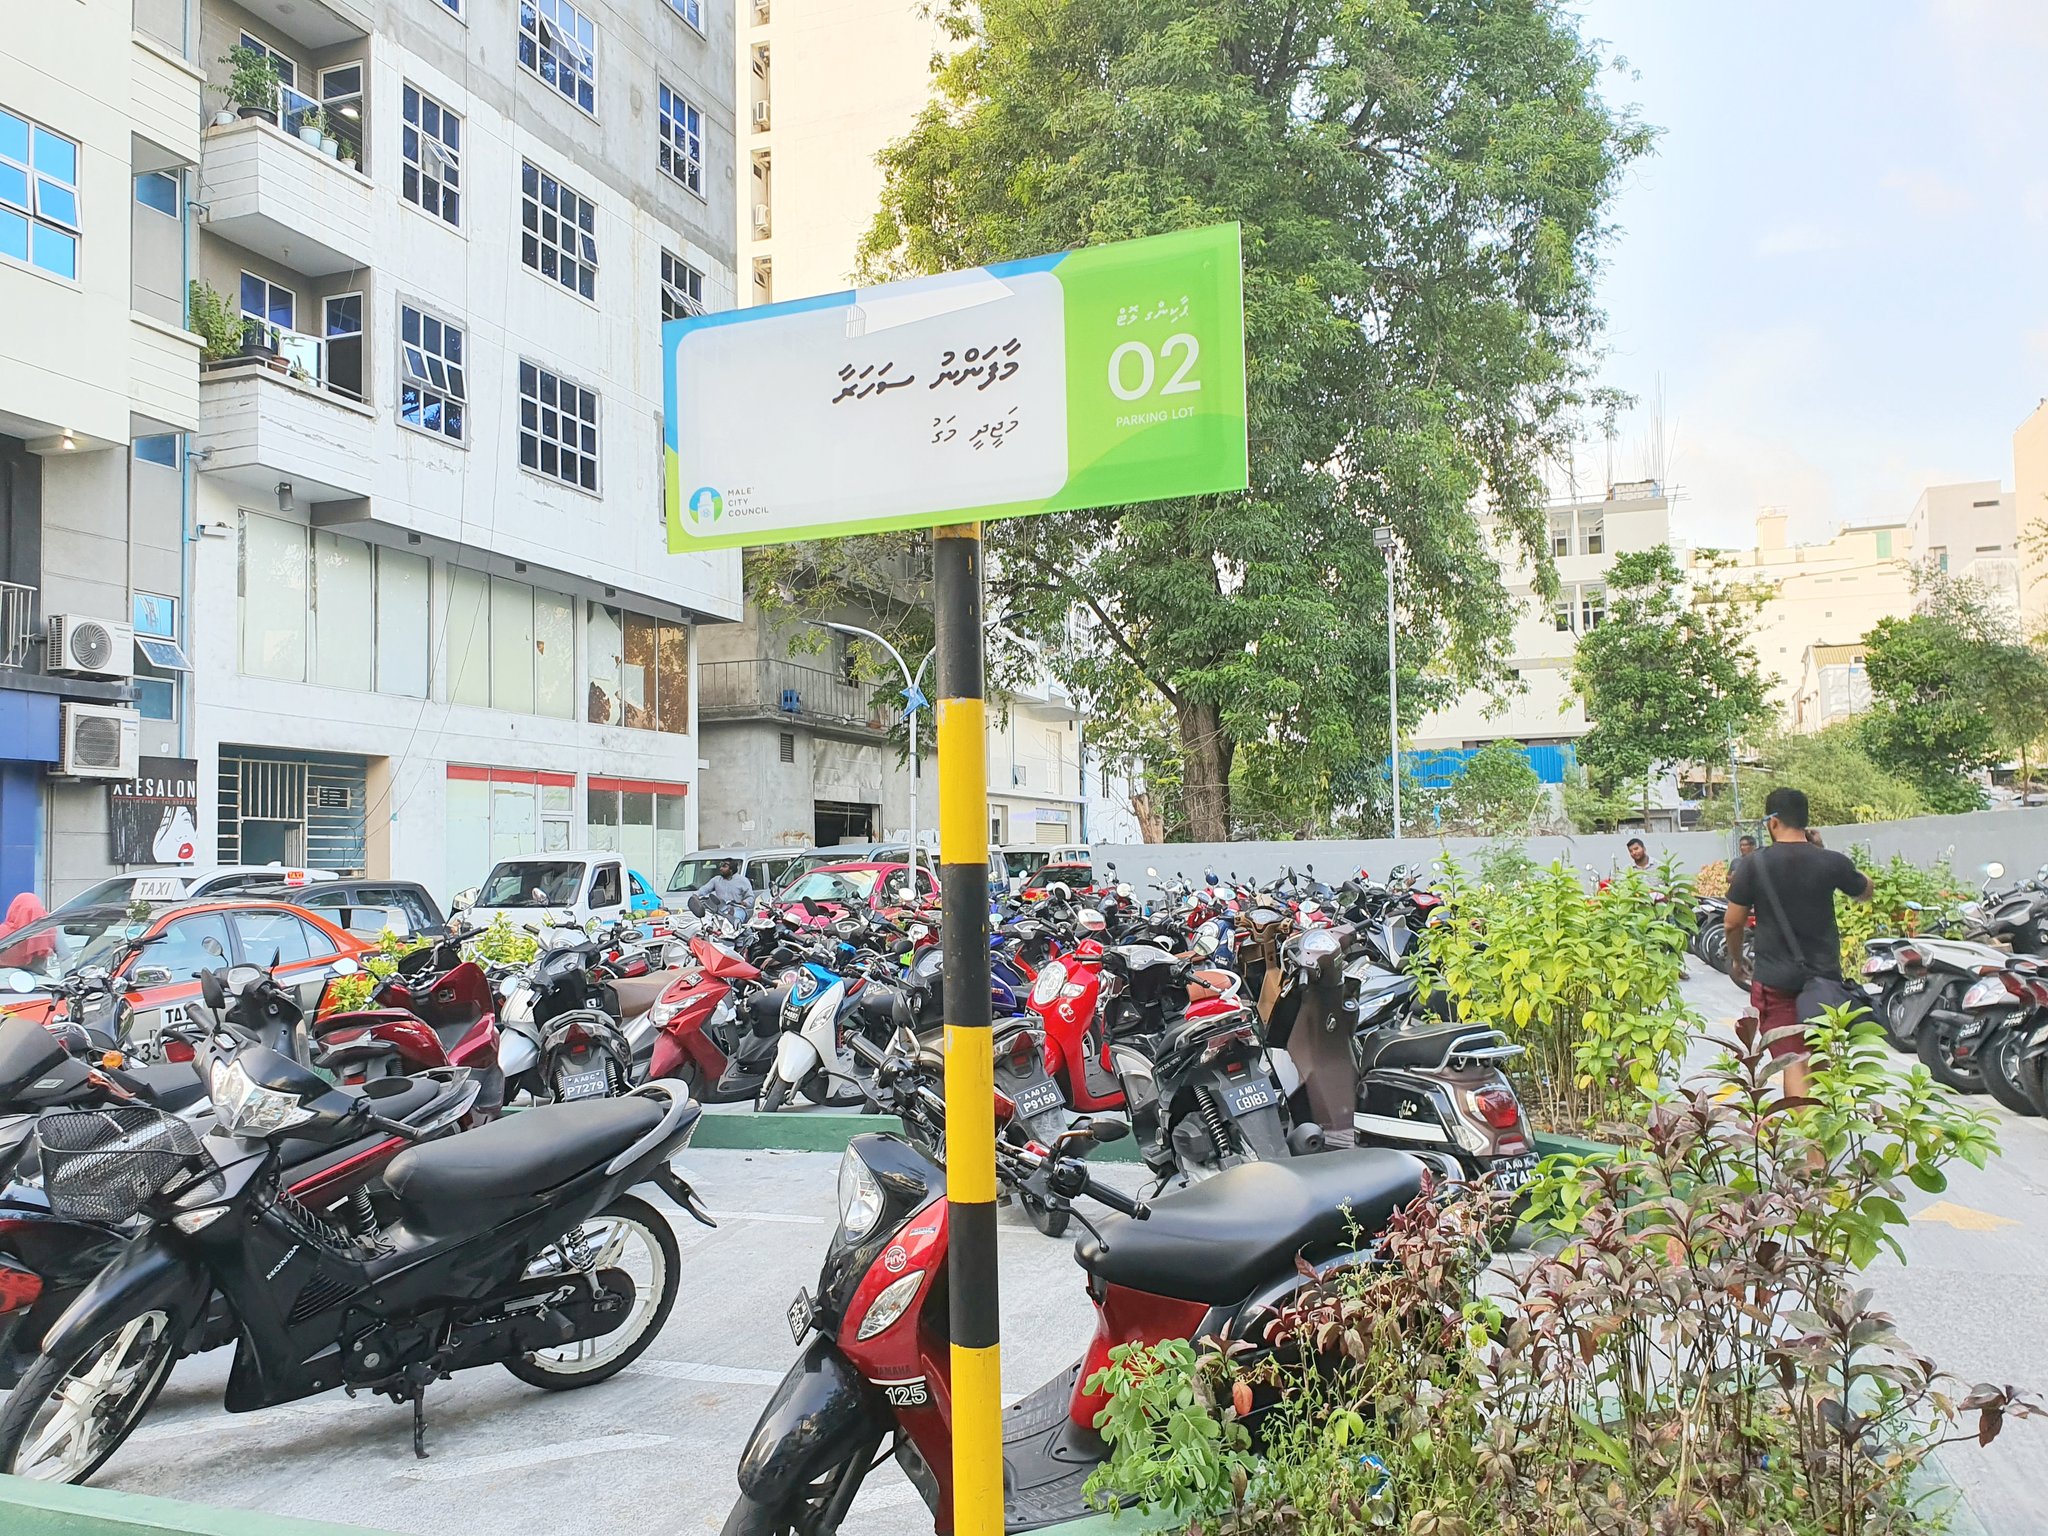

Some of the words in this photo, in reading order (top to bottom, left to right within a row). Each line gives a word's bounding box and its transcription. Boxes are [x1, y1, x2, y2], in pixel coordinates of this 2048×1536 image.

[929, 338, 1021, 391] މާފަންނު
[1108, 333, 1201, 401] 02
[832, 361, 915, 404] ސަހަރާ
[1116, 411, 1168, 427] PARKING
[1172, 406, 1194, 420] LOT
[931, 415, 957, 444] މަގު
[968, 406, 1019, 450] މަޖީދީ
[728, 498, 749, 507] CITY
[728, 506, 769, 518] COUNCIL
[140, 882, 171, 896] TAXI
[567, 1081, 605, 1096] P7279
[1023, 1092, 1057, 1112] P9159
[1236, 1091, 1269, 1110] C8183
[265, 1244, 300, 1280] HONDA
[885, 1382, 928, 1405] 125
